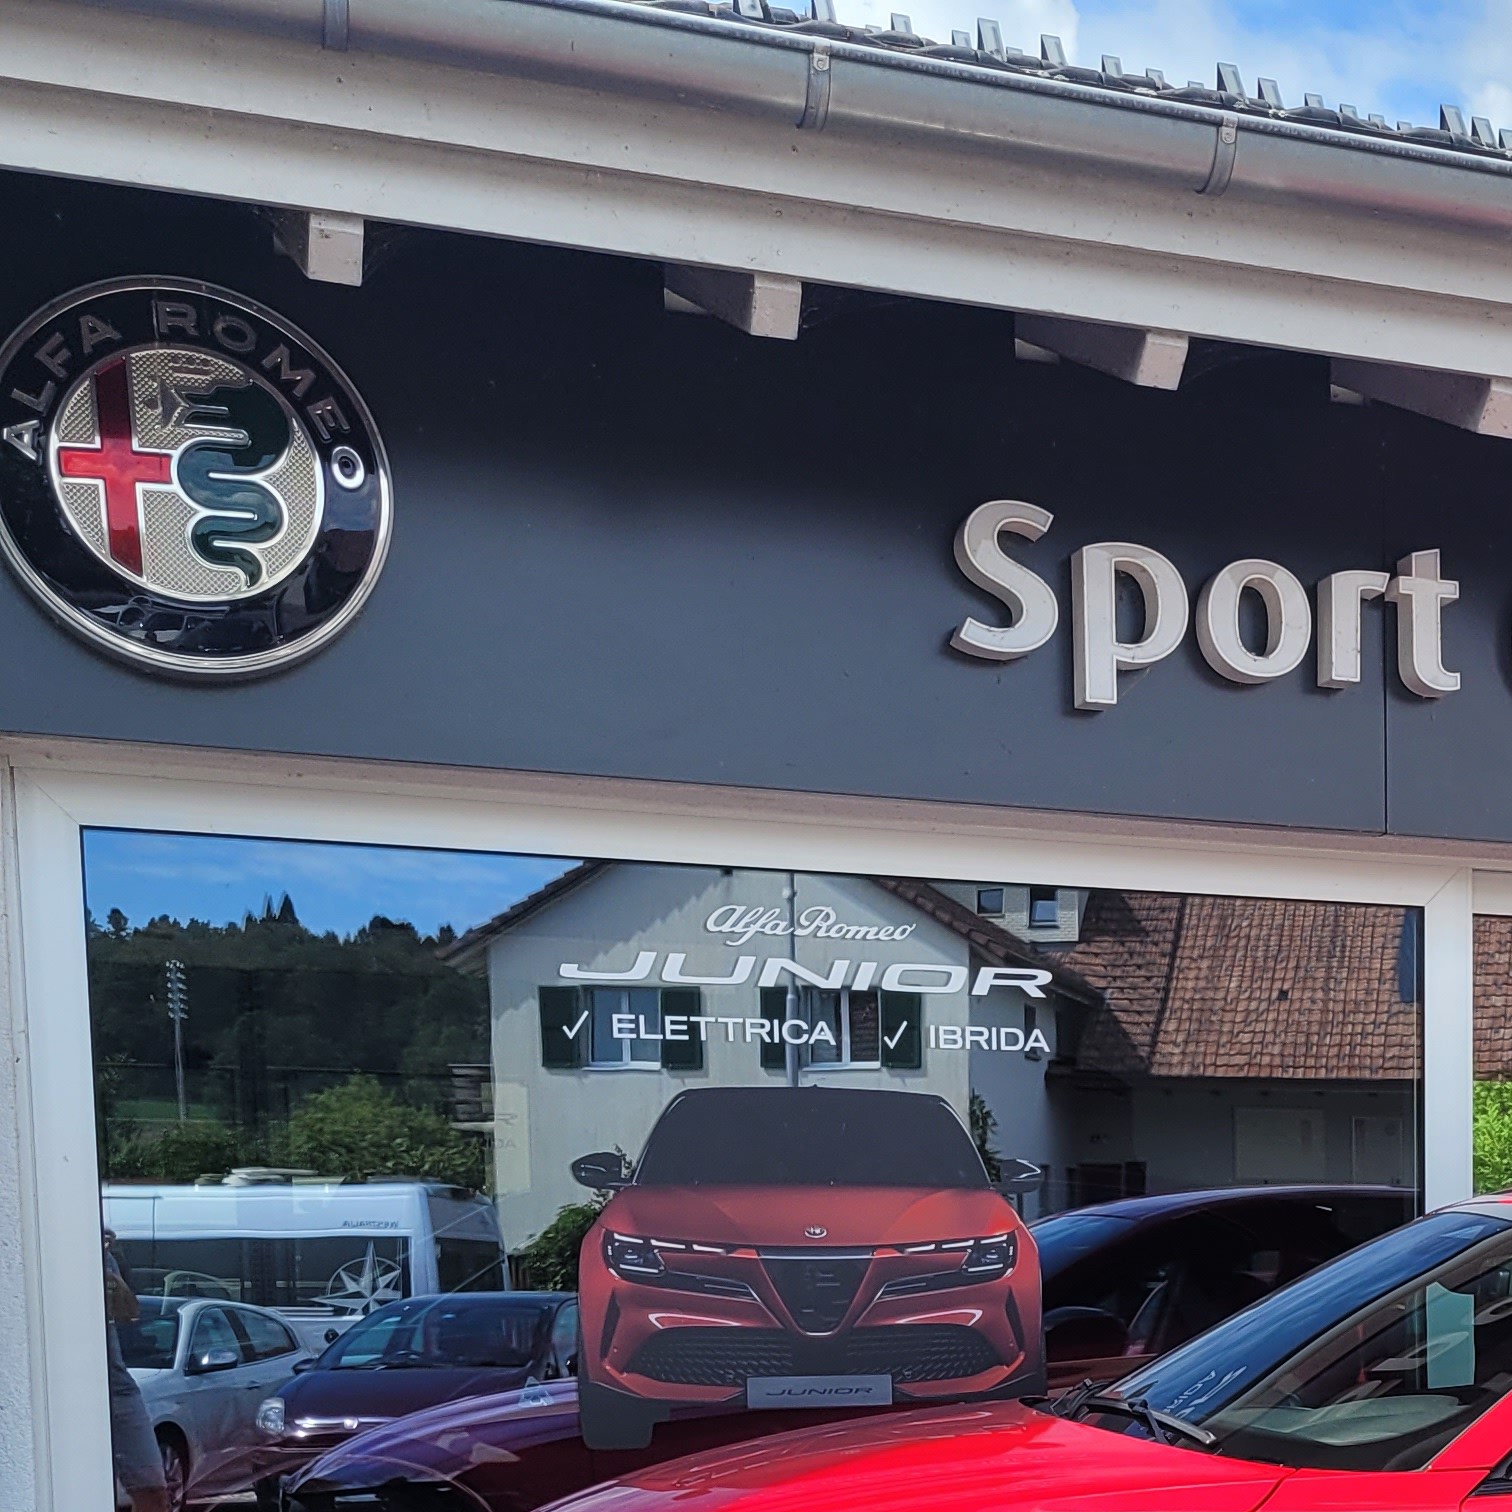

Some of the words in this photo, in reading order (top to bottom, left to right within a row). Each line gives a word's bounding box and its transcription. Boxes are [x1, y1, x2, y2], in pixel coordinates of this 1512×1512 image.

[3, 313, 122, 466] ALFA
[157, 302, 366, 490] ROMEO
[949, 499, 1462, 710] Sport
[705, 904, 794, 946] Alfa
[793, 906, 917, 942] Romeo
[559, 950, 1055, 999] JUNIOR
[611, 1013, 837, 1047] ELETTRICA
[929, 1024, 1051, 1053] IBRIDA
[765, 1387, 873, 1396] JUNIOR
